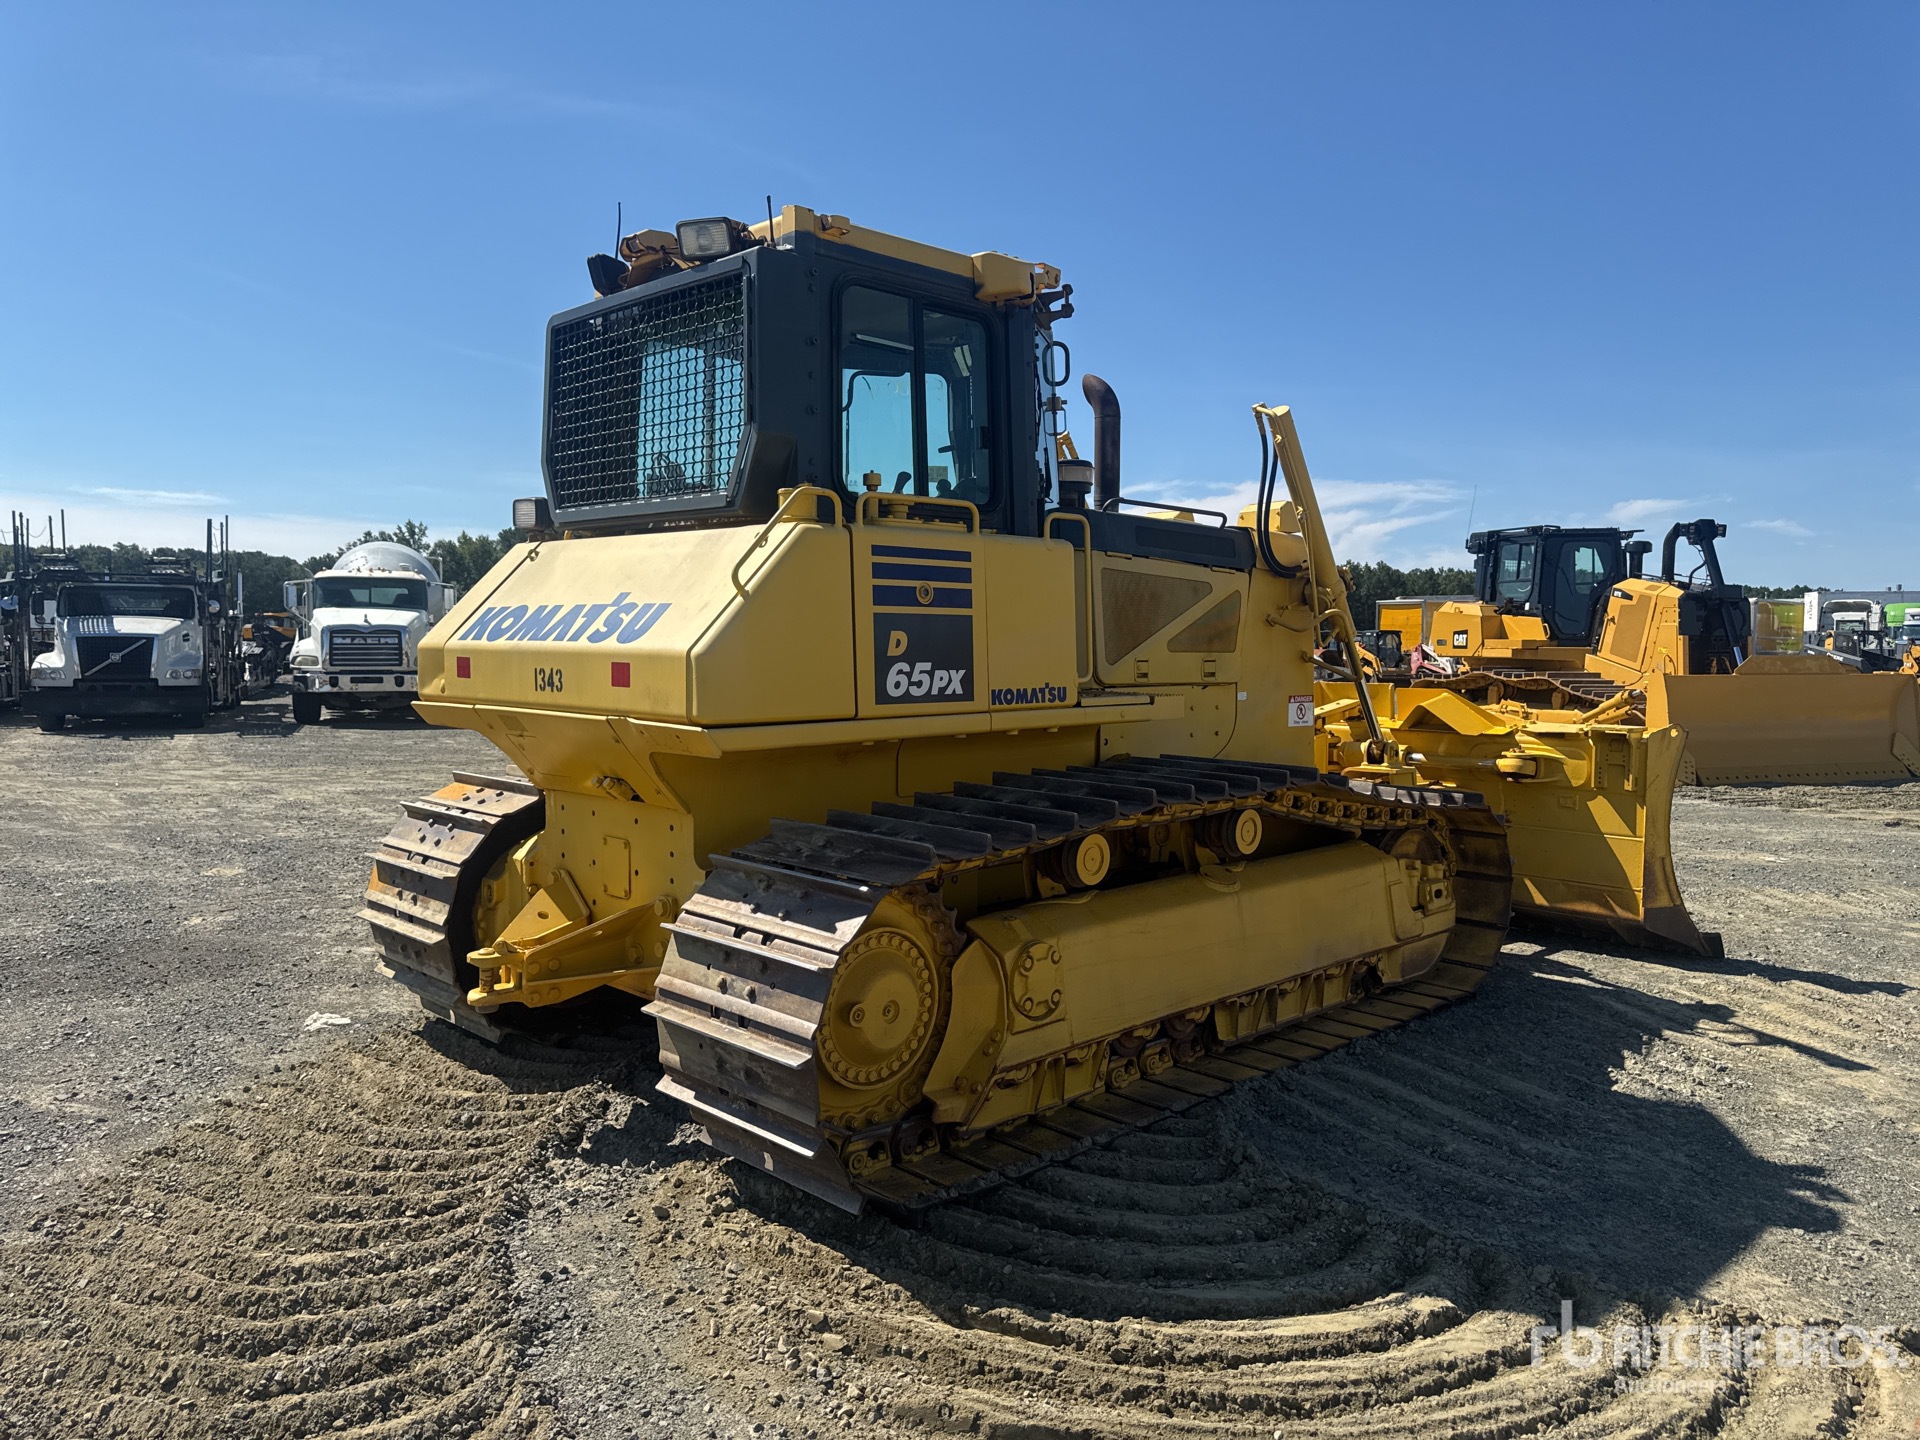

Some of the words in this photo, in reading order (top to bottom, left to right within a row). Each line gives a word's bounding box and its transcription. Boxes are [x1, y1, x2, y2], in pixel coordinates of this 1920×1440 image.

[458, 592, 672, 644] KOMATSU
[887, 630, 908, 657] D
[1453, 633, 1467, 646] CAT
[534, 668, 564, 693] 1343
[886, 661, 966, 697] 65PX
[991, 682, 1067, 705] KOMATSU
